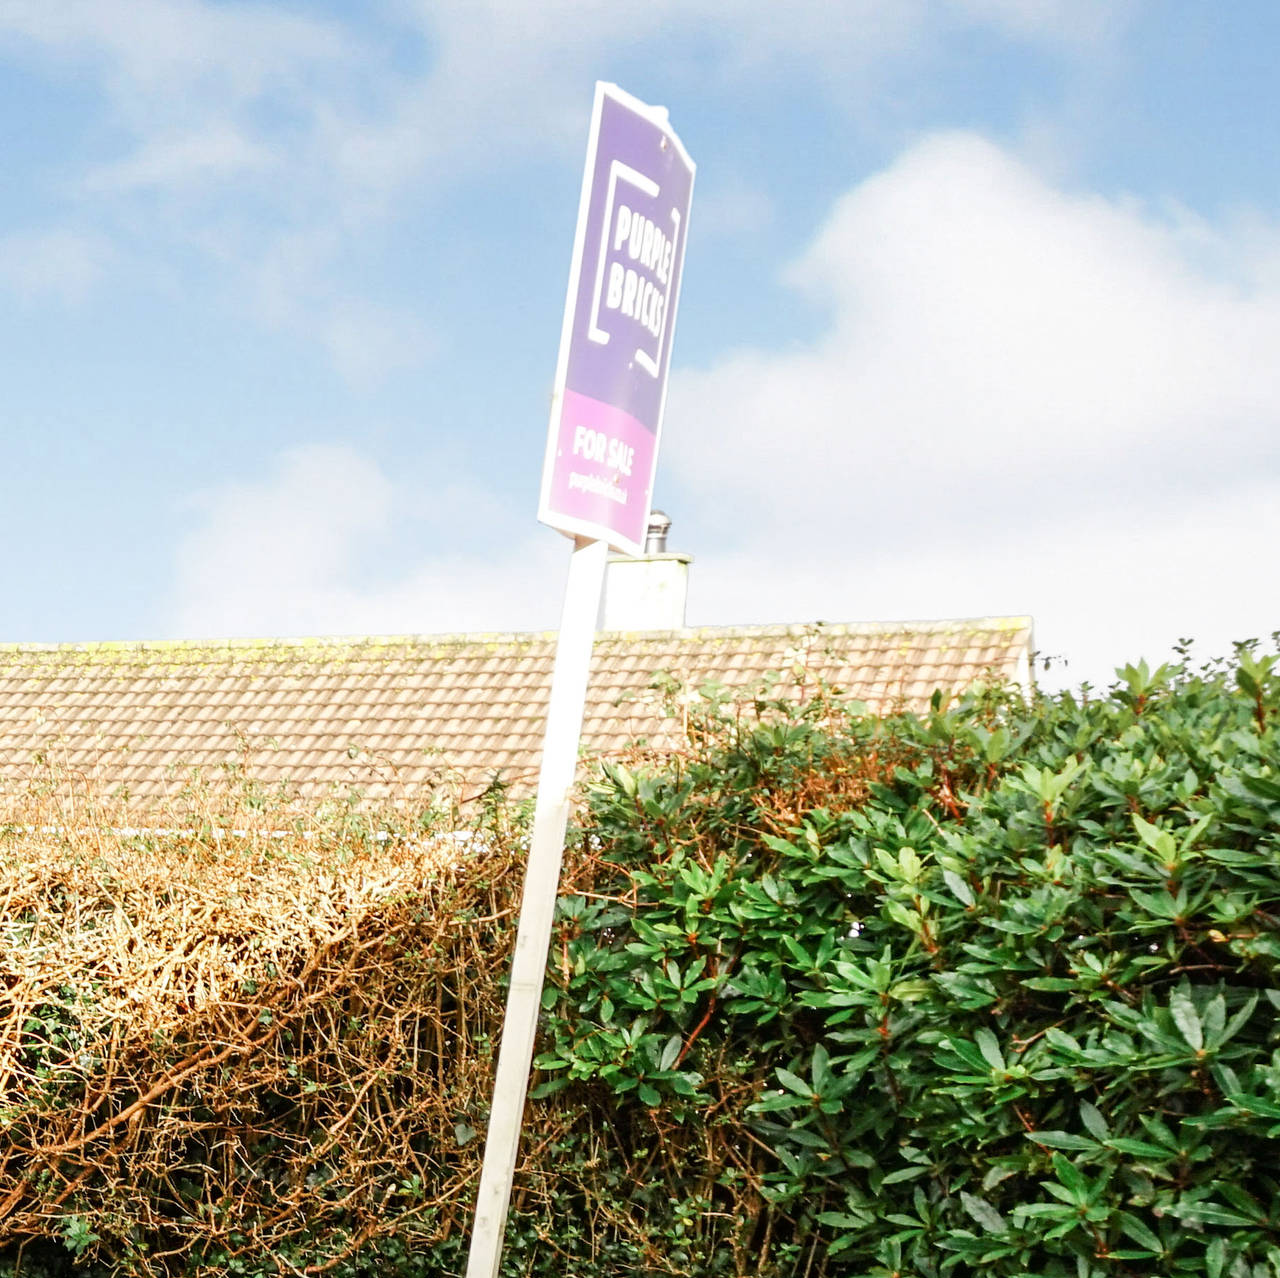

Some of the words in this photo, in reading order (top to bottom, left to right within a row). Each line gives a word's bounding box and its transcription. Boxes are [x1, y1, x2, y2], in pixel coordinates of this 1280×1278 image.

[614, 205, 671, 284] PURPLE
[606, 262, 664, 337] BRICKS
[573, 425, 607, 463] FOR
[607, 438, 635, 476] SALE
